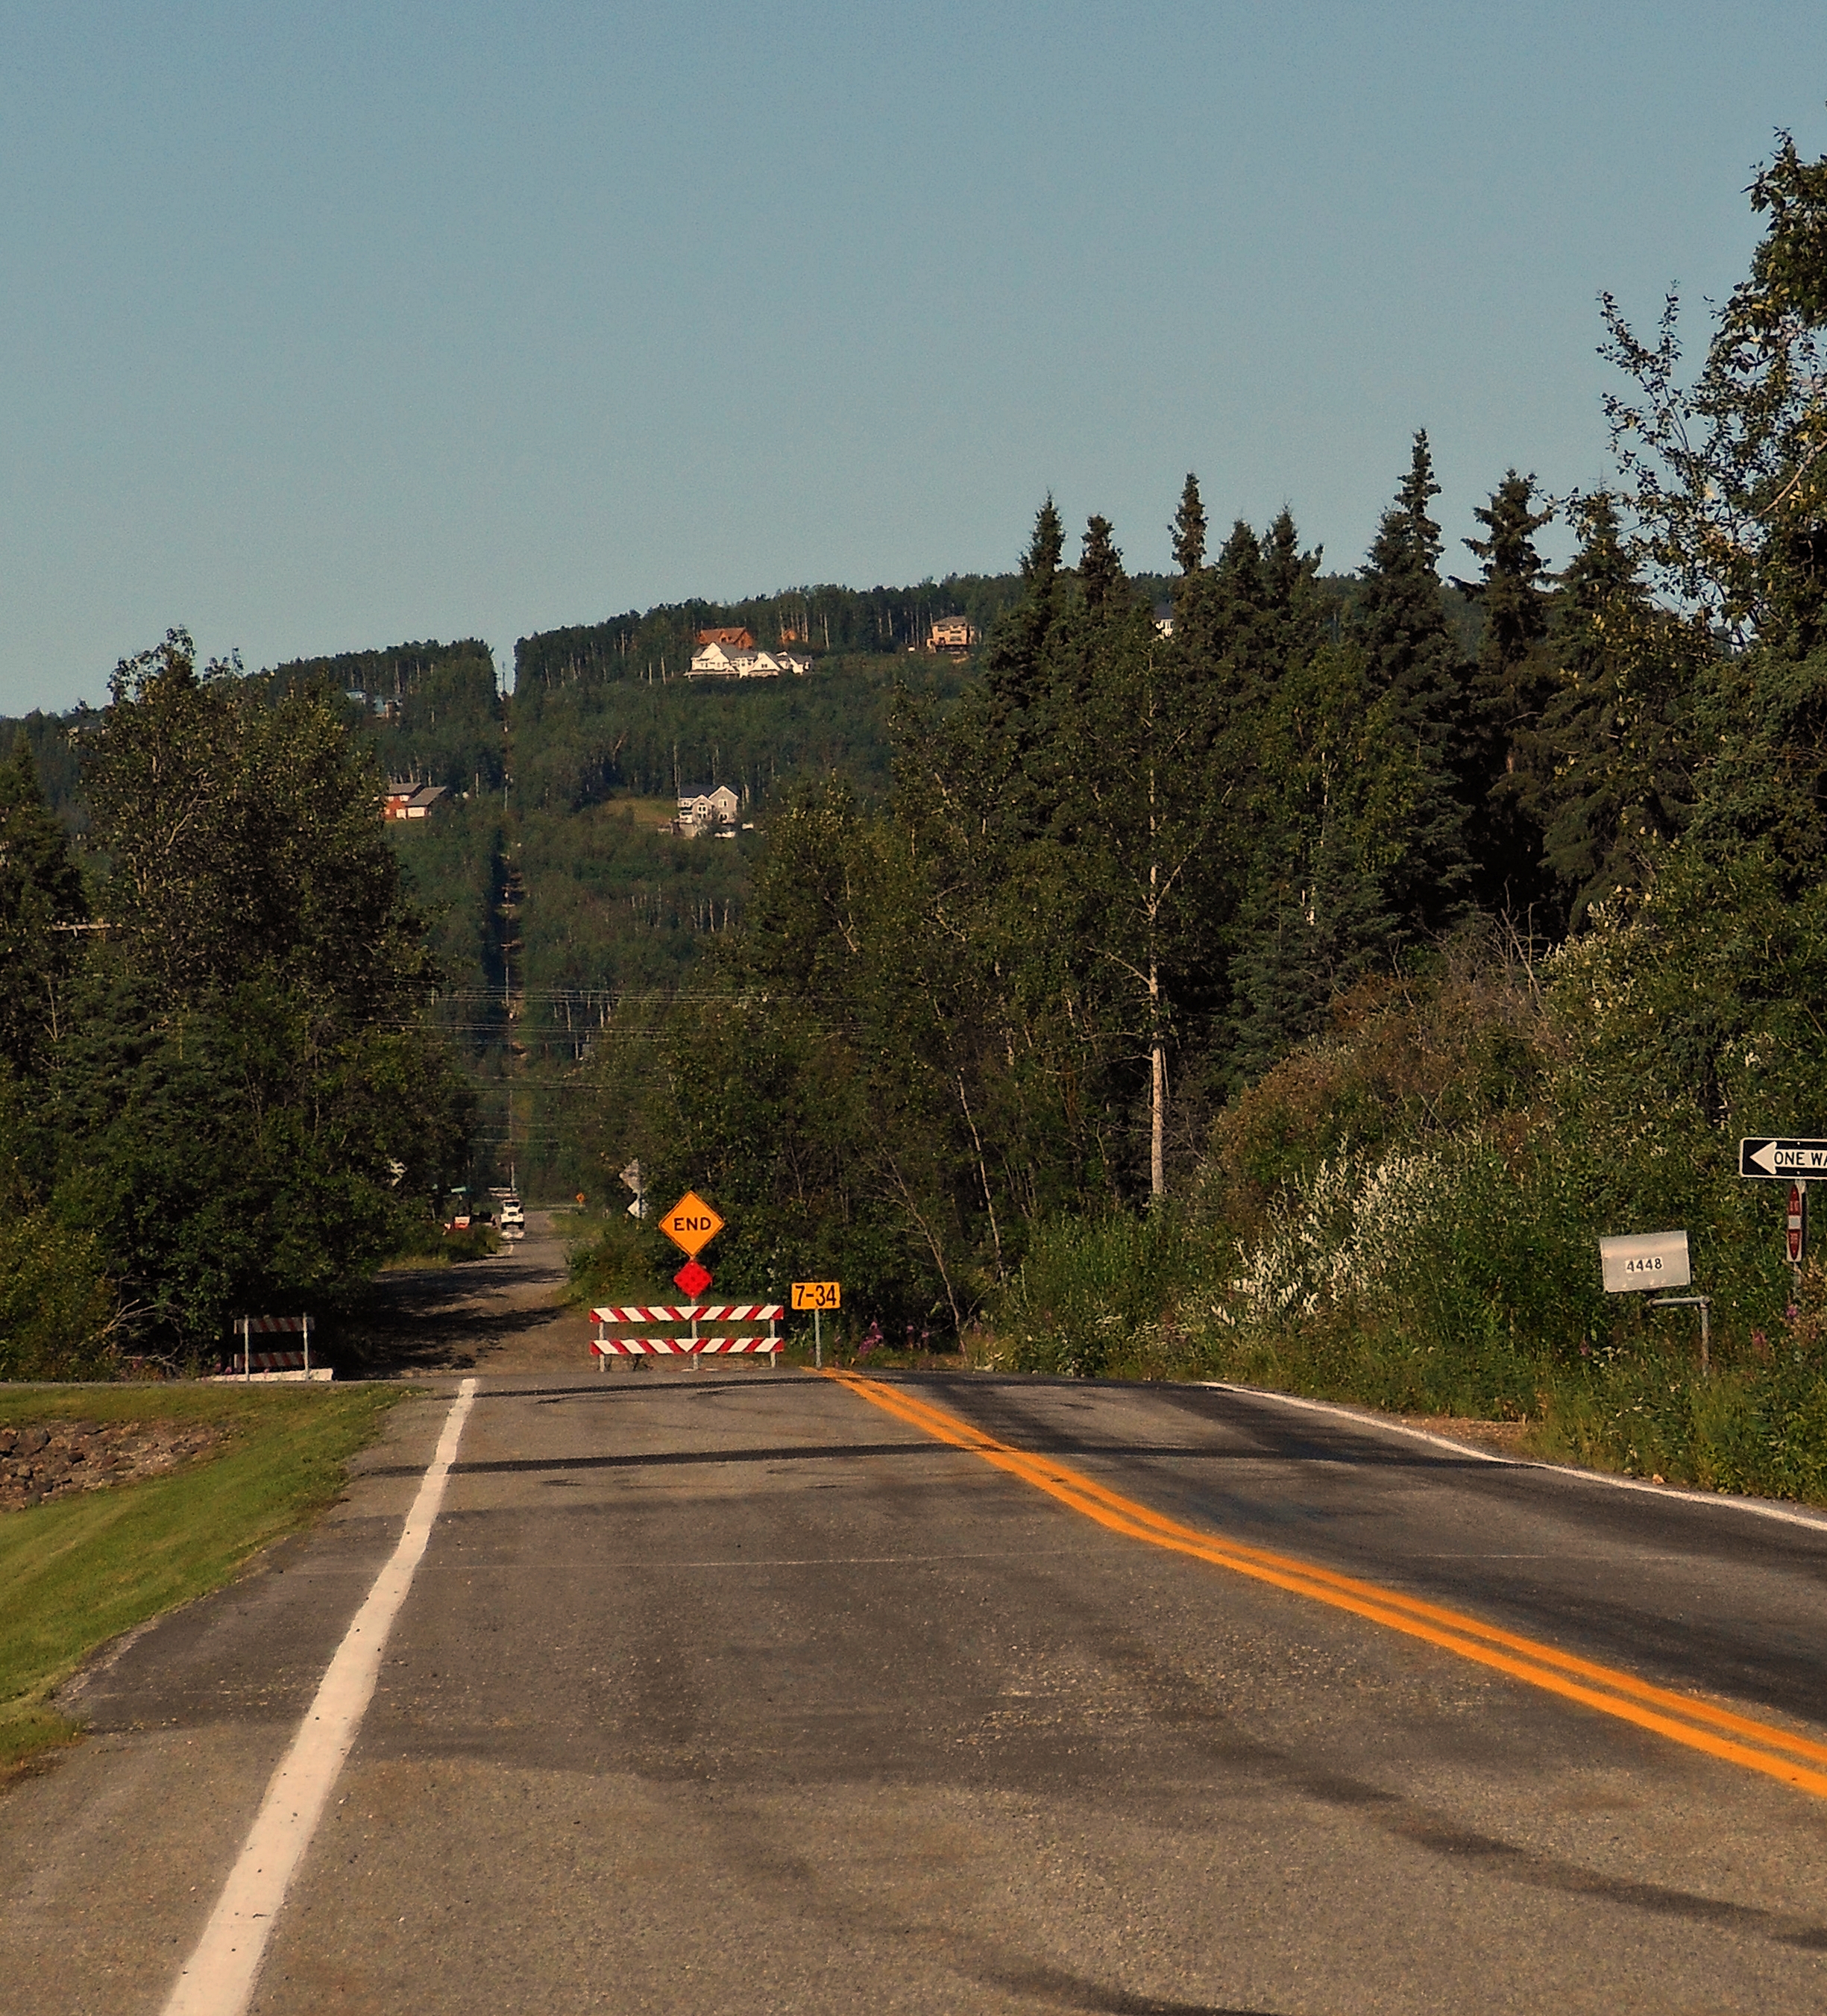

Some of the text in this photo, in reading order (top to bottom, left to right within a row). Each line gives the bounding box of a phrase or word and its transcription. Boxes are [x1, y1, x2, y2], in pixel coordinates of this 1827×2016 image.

[1774, 1151, 1805, 1166] ONE
[673, 1216, 711, 1231] END
[1626, 1257, 1662, 1272] 4448
[795, 1284, 837, 1307] 7-34
